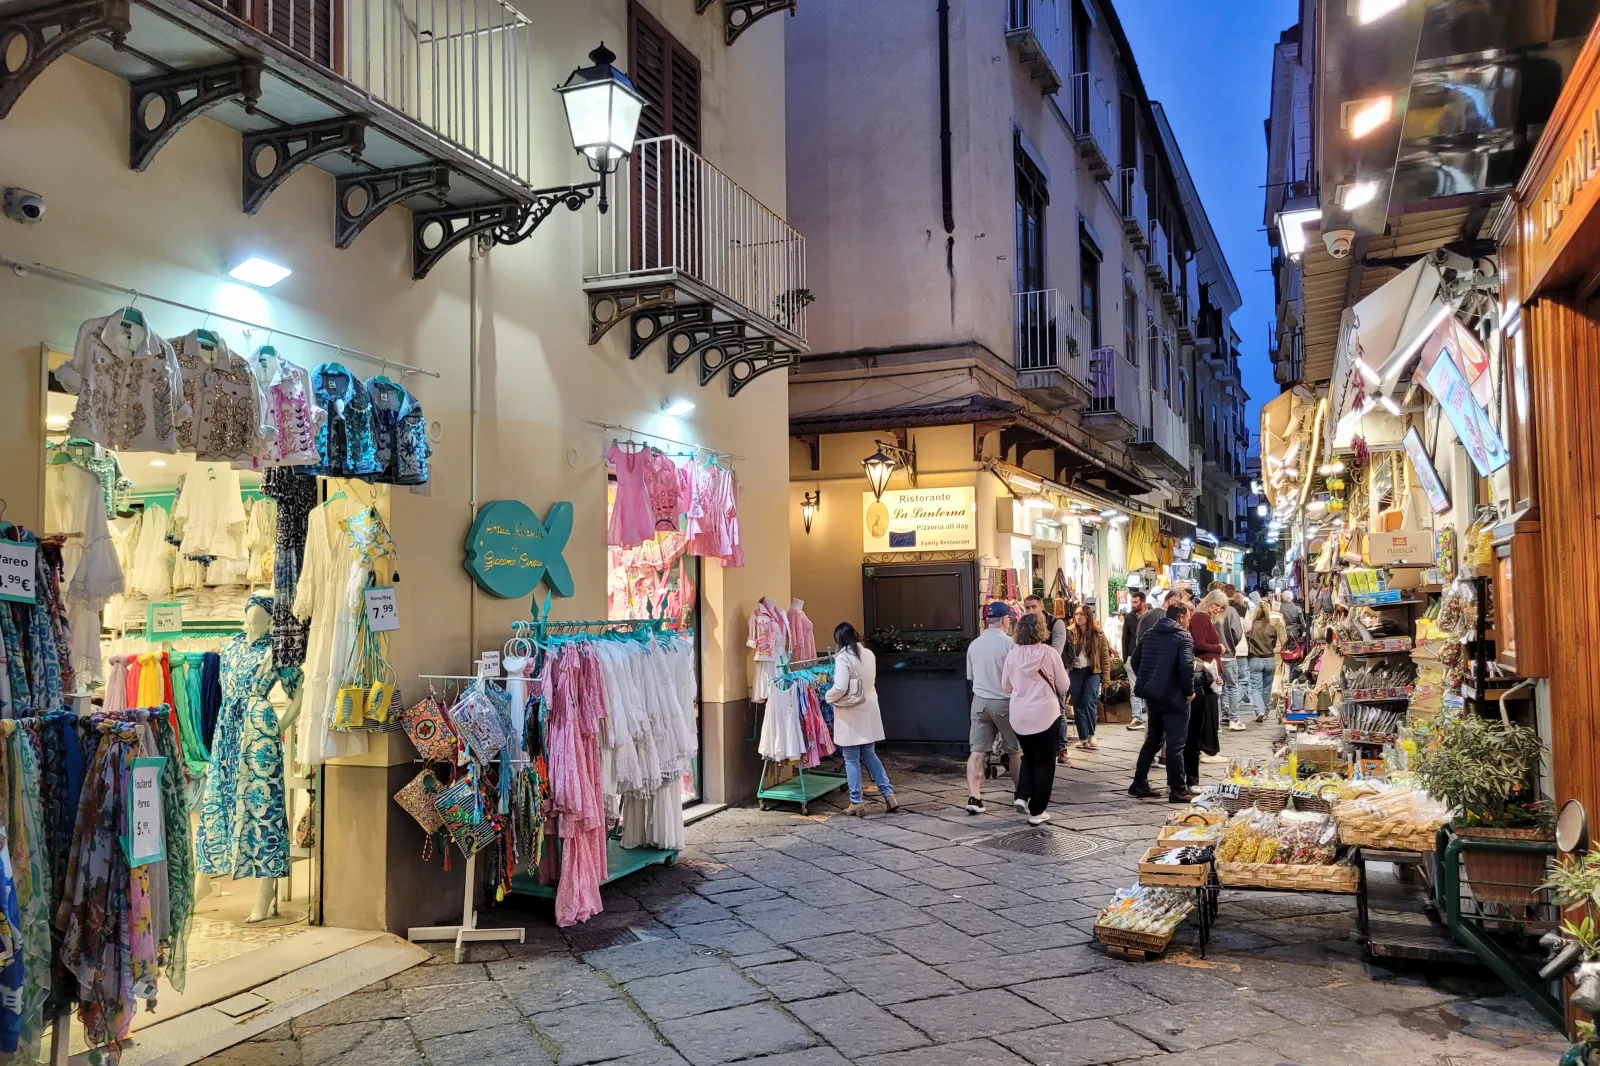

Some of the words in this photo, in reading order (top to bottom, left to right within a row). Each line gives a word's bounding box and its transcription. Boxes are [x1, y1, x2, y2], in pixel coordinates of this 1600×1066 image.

[899, 493, 951, 503] Ristorante
[892, 508, 908, 520] La
[910, 507, 966, 519] Lanterna
[956, 523, 969, 531] day
[484, 550, 517, 571] Giacomo
[134, 778, 152, 789] Foulard
[137, 799, 151, 808] Pareo
